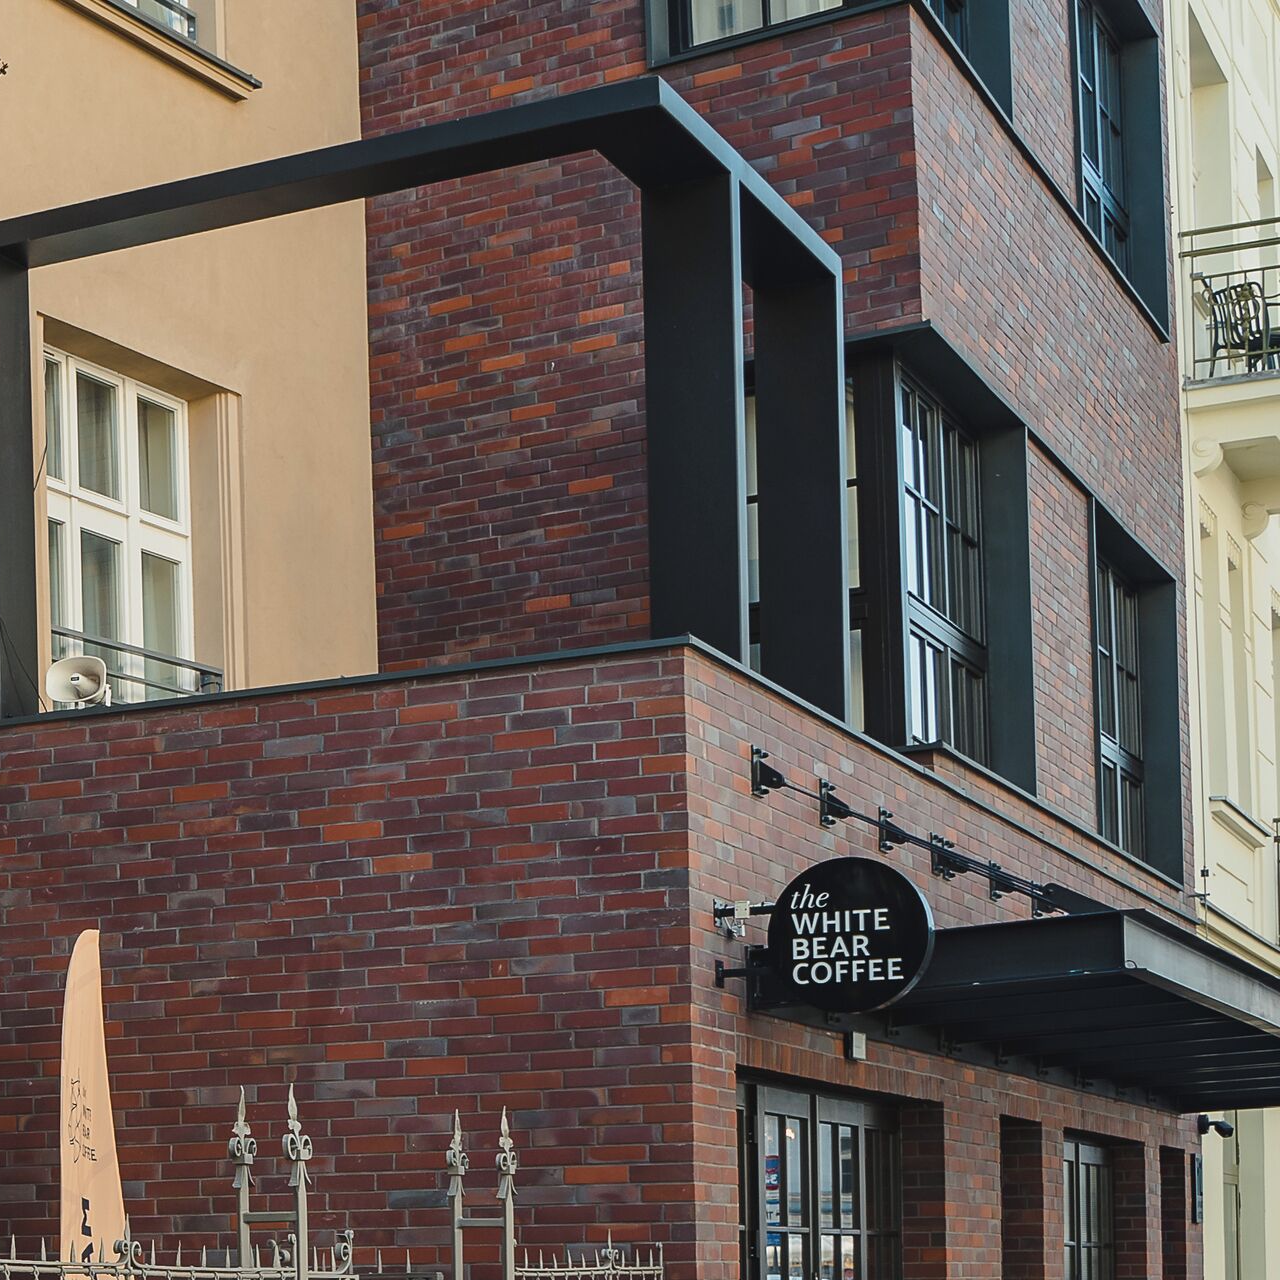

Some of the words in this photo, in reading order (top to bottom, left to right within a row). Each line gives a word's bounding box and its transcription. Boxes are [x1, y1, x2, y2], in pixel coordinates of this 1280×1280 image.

[790, 883, 830, 910] the
[791, 908, 891, 935] WHITE
[792, 934, 871, 960] BEAR
[792, 957, 905, 985] COFFEE
